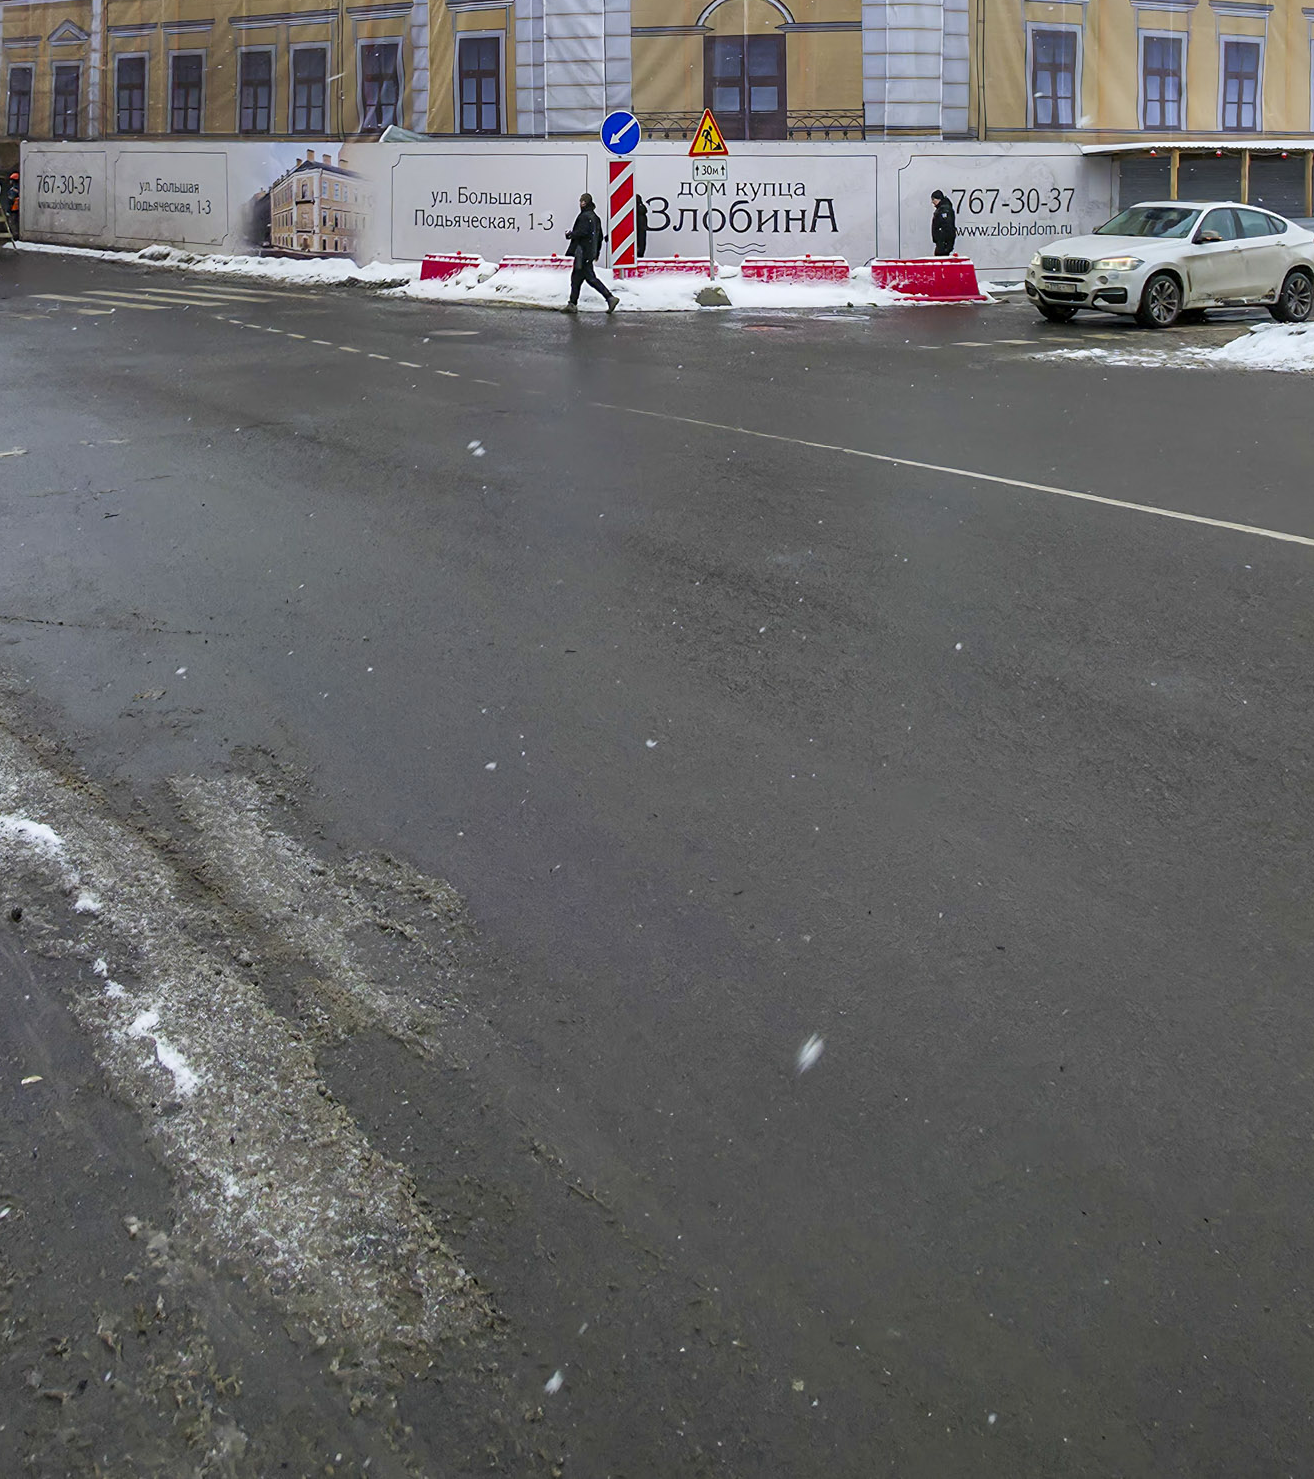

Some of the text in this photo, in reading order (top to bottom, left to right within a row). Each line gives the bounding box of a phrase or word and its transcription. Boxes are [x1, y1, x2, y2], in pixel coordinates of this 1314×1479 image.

[701, 164, 719, 176] 30м
[36, 175, 92, 195] 767-30-37
[139, 177, 200, 196] ул. Большая
[677, 181, 806, 202] дом купца
[128, 196, 212, 215] Подьяческая, 1-3
[431, 186, 533, 208] ул. Большая
[951, 187, 1076, 215] 767-30-37
[414, 208, 555, 233] Подьяческая, 1-3
[645, 196, 840, 234] ЗлобинА
[955, 221, 1073, 238] www.zlobindom.ru
